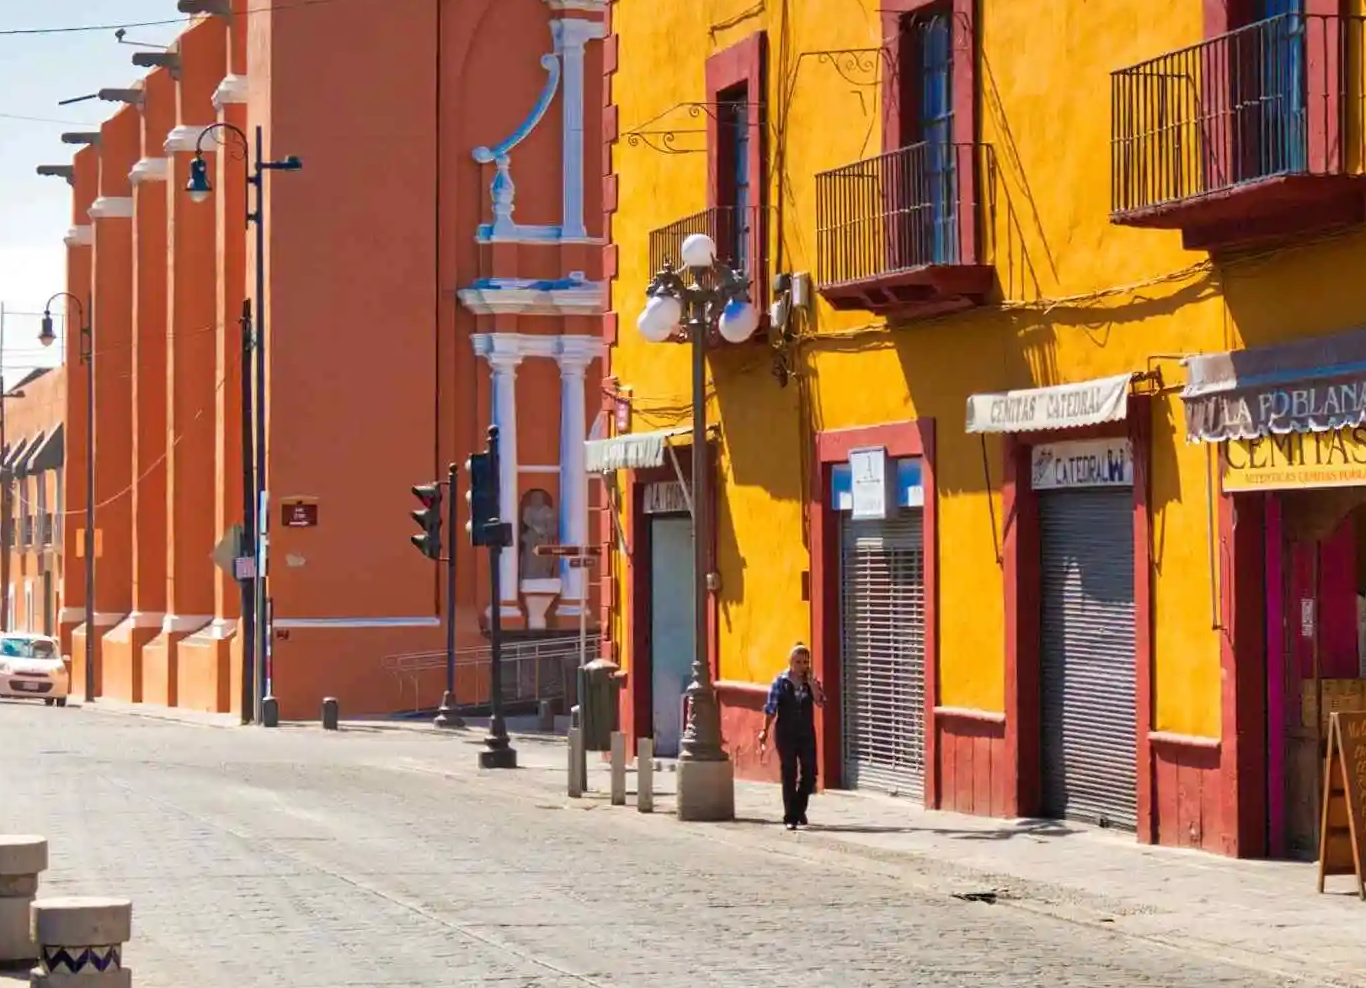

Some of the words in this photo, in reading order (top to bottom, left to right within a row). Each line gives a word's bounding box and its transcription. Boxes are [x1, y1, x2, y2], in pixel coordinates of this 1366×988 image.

[991, 396, 1035, 423] CEMITAS
[1046, 388, 1103, 419] CATEDRAL
[1222, 396, 1252, 426] LA
[1055, 456, 1108, 485] CATEDRAL
